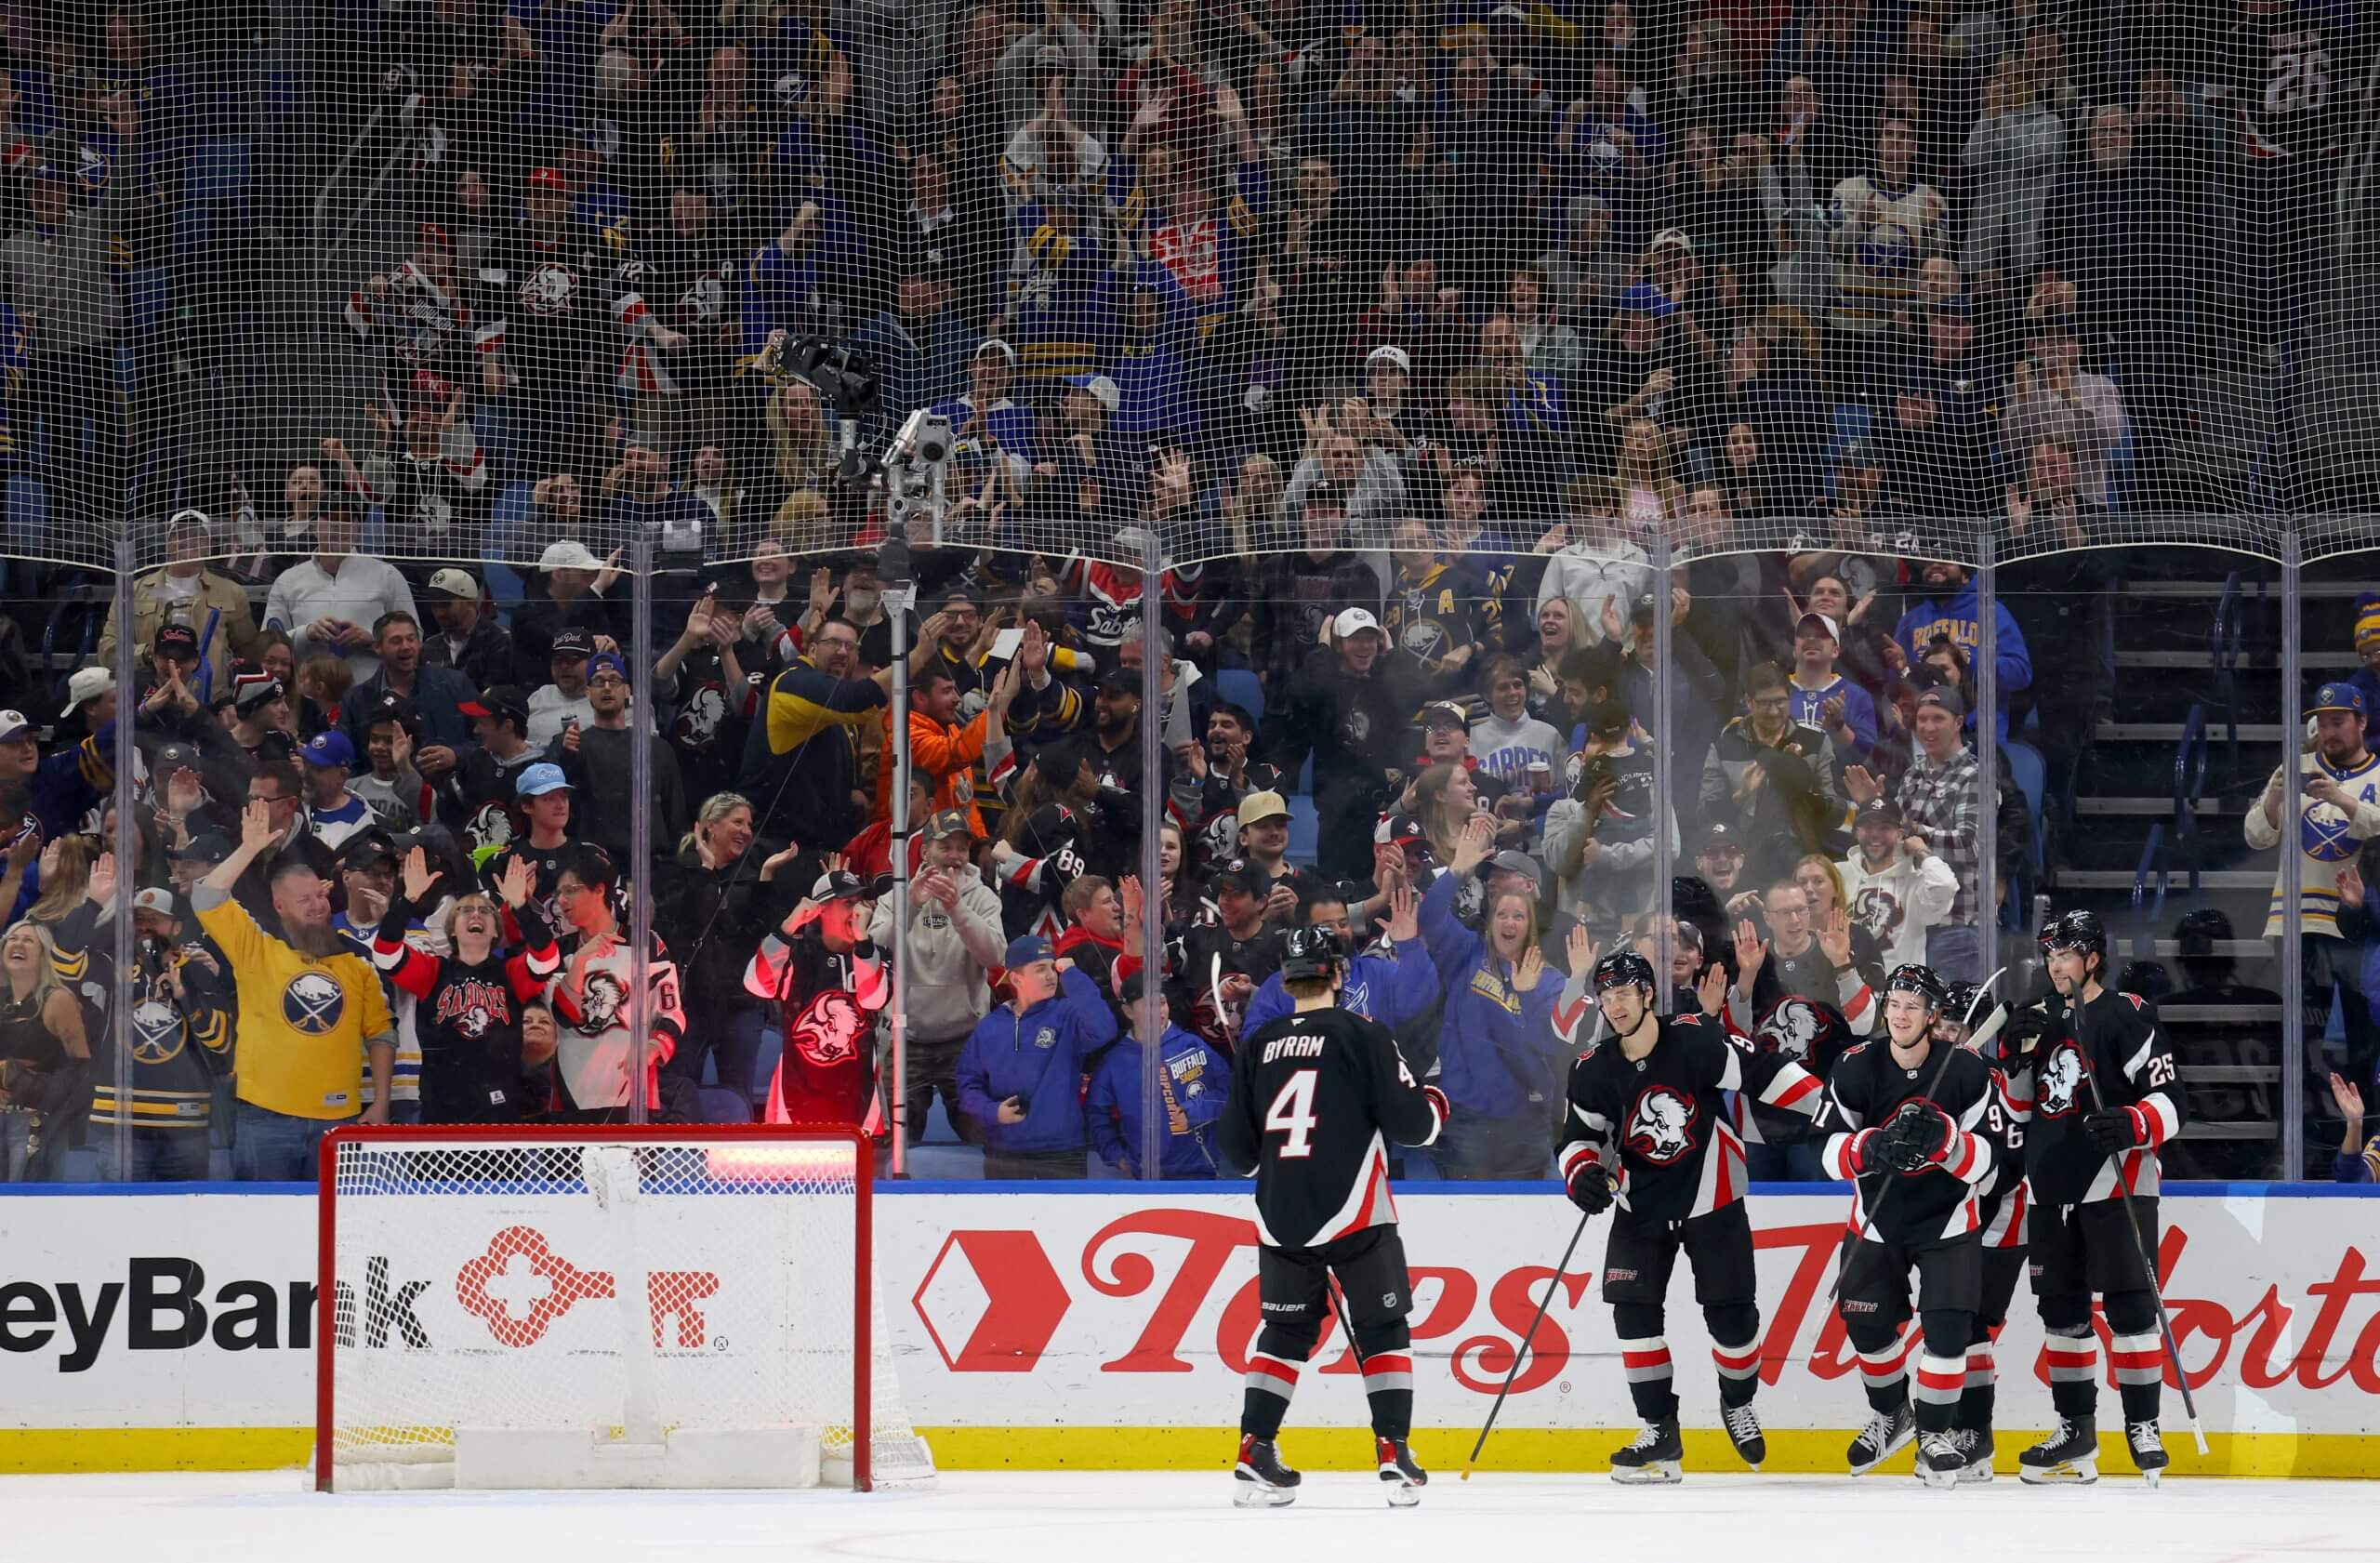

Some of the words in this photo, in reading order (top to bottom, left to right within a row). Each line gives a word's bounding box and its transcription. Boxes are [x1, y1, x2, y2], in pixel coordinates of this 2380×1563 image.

[2264, 52, 2329, 112] 26
[1436, 589, 1456, 616] A
[2359, 783, 2376, 804] A
[1056, 848, 1086, 879] 89
[1170, 1050, 1208, 1080] BUFFALO
[1263, 1035, 1327, 1065] BYRAM
[2148, 1052, 2176, 1089] 25
[1264, 1067, 1321, 1160] 4
